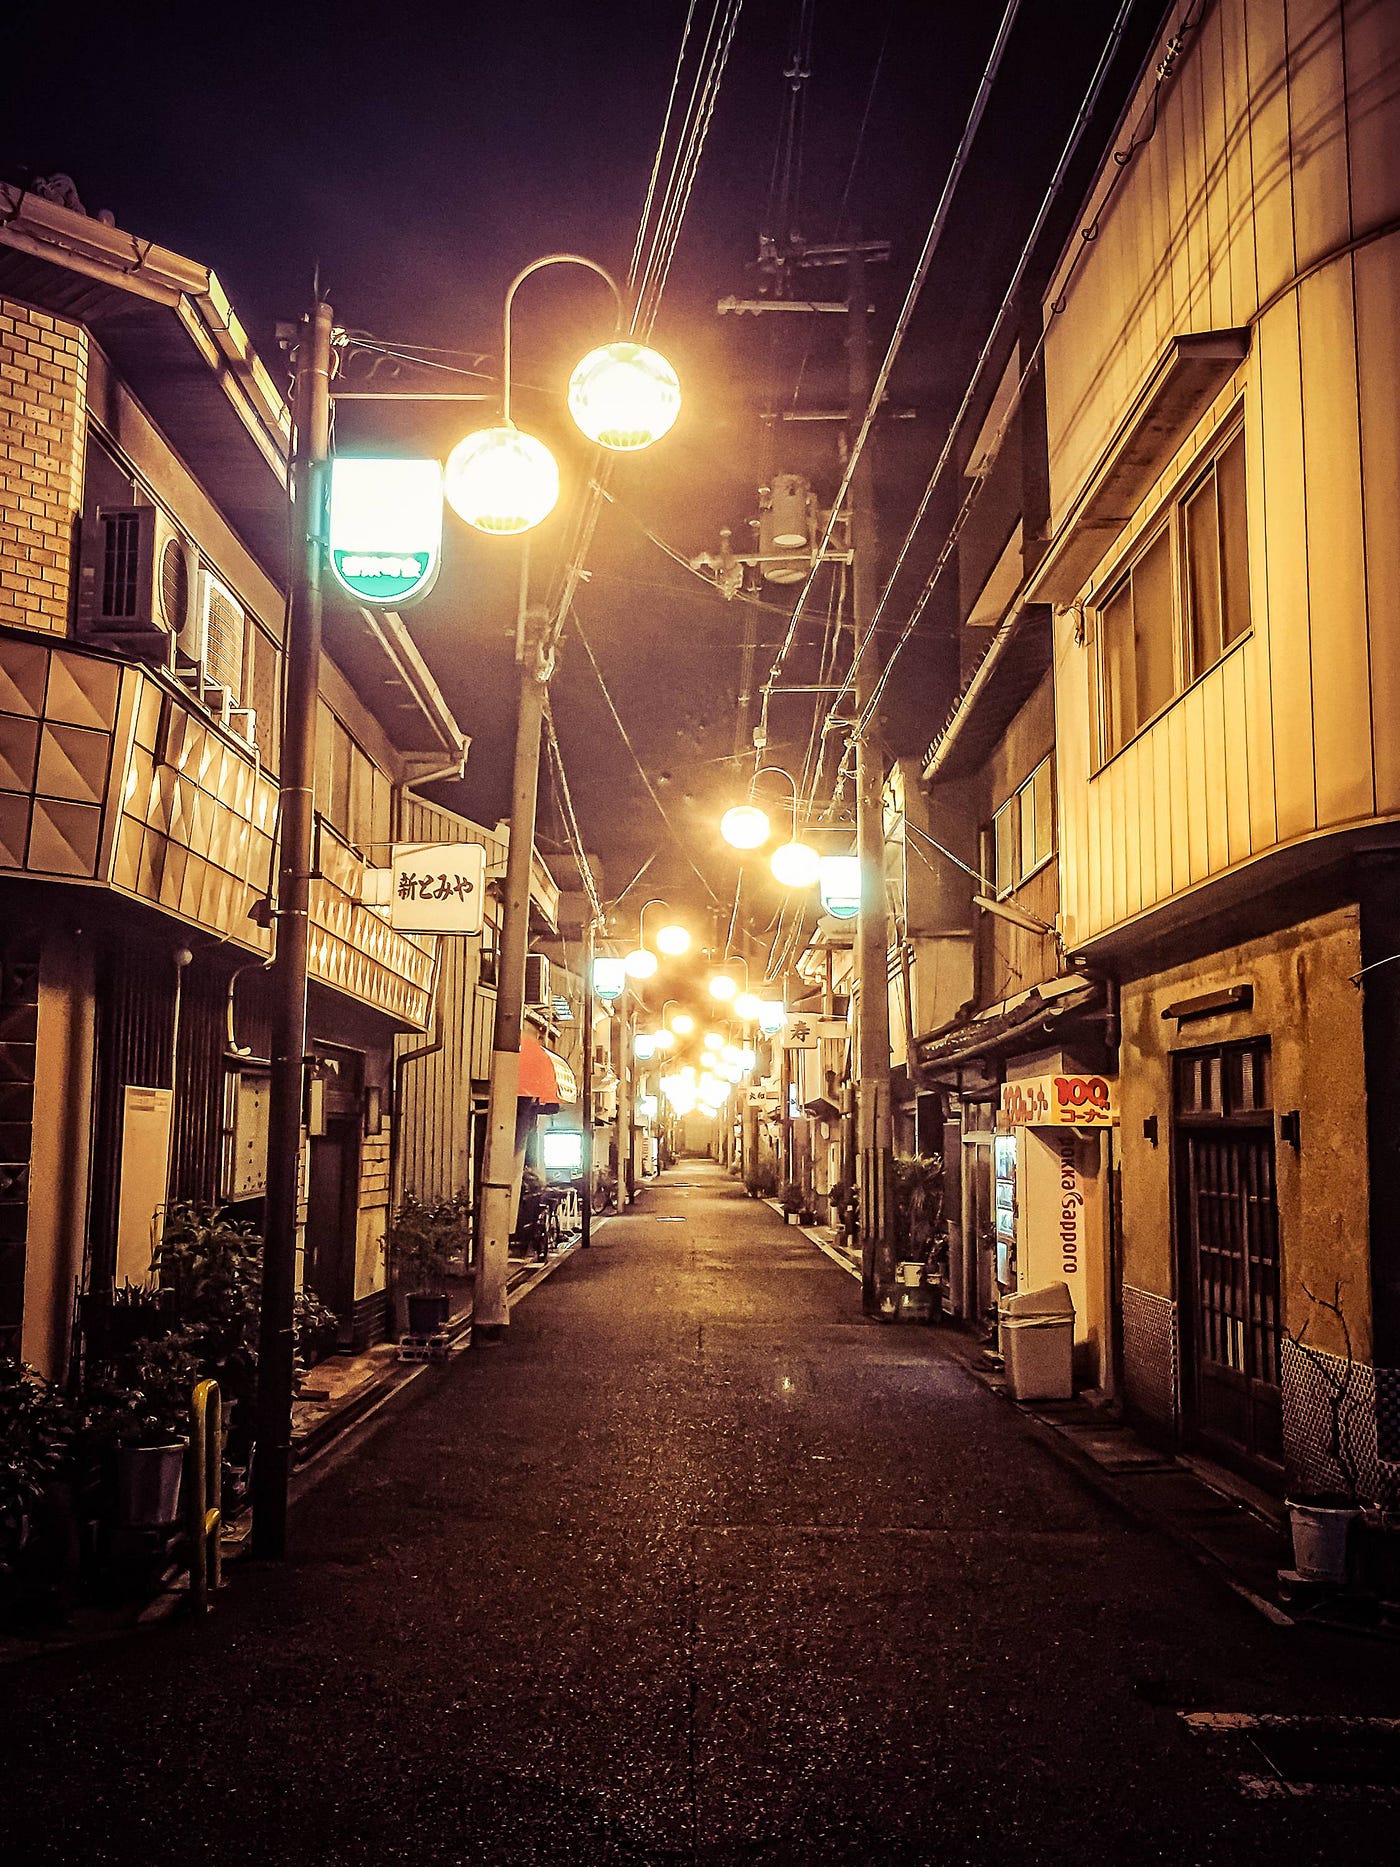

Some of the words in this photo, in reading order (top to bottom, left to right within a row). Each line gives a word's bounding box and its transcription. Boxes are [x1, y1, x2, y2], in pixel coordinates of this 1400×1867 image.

[397, 871, 474, 903] 新とみや
[790, 1020, 811, 1043] 寿
[1060, 1108, 1109, 1123] コーナー
